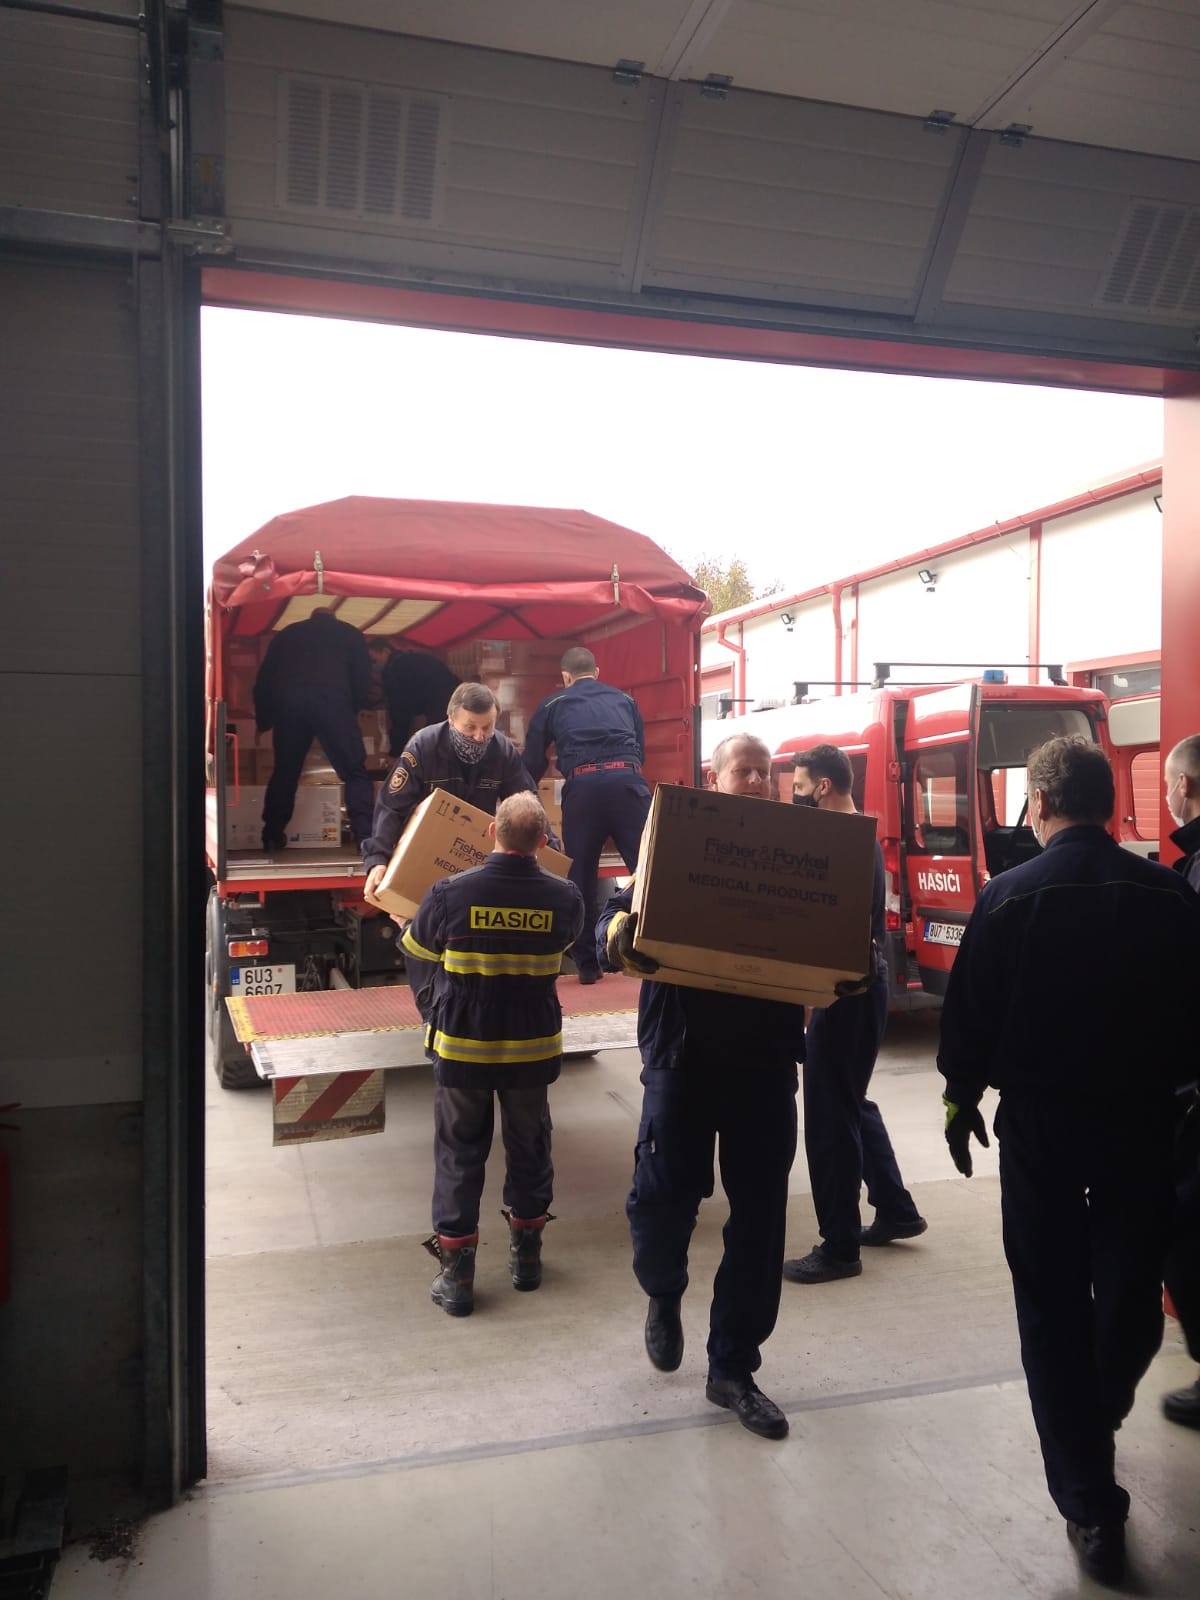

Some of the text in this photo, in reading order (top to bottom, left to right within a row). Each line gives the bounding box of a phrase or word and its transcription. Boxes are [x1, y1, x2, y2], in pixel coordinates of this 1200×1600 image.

[453, 837, 489, 862] Fisher
[703, 855, 826, 881] HEALTHCARE
[917, 868, 961, 893] HASIČI
[688, 872, 838, 906] MEDICAL PRODUCTS
[474, 910, 550, 930] HASIČI
[245, 968, 273, 985] 6U3
